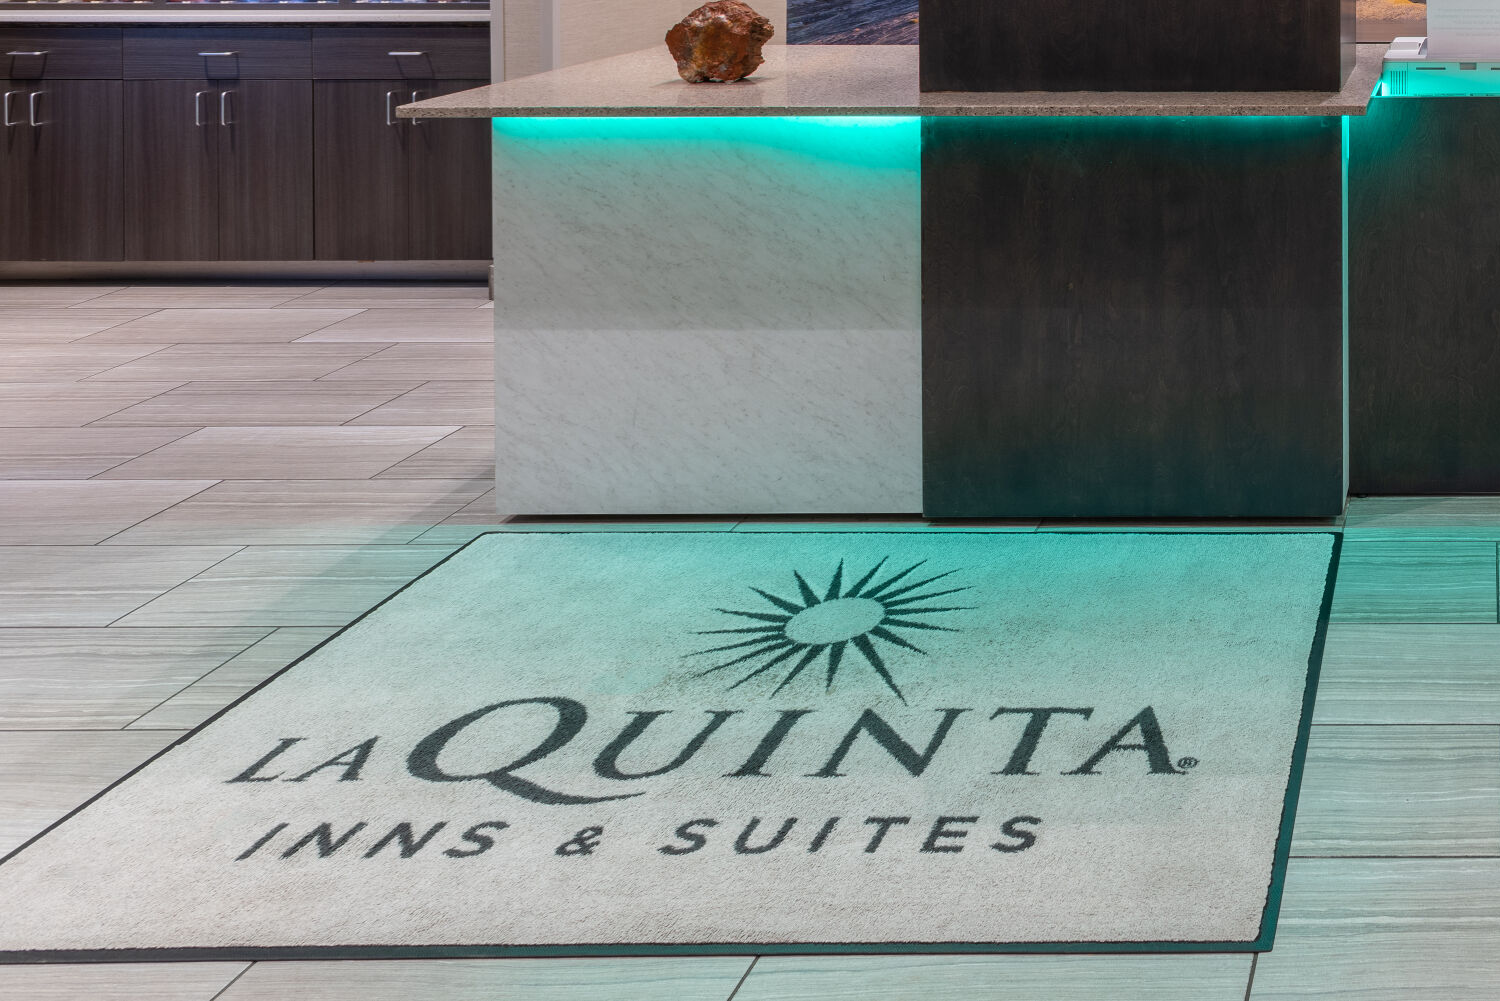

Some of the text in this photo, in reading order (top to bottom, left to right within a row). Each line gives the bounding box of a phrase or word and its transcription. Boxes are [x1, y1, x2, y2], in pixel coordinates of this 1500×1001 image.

[225, 736, 382, 784] LA
[236, 815, 1044, 860] INNS & SUITES
